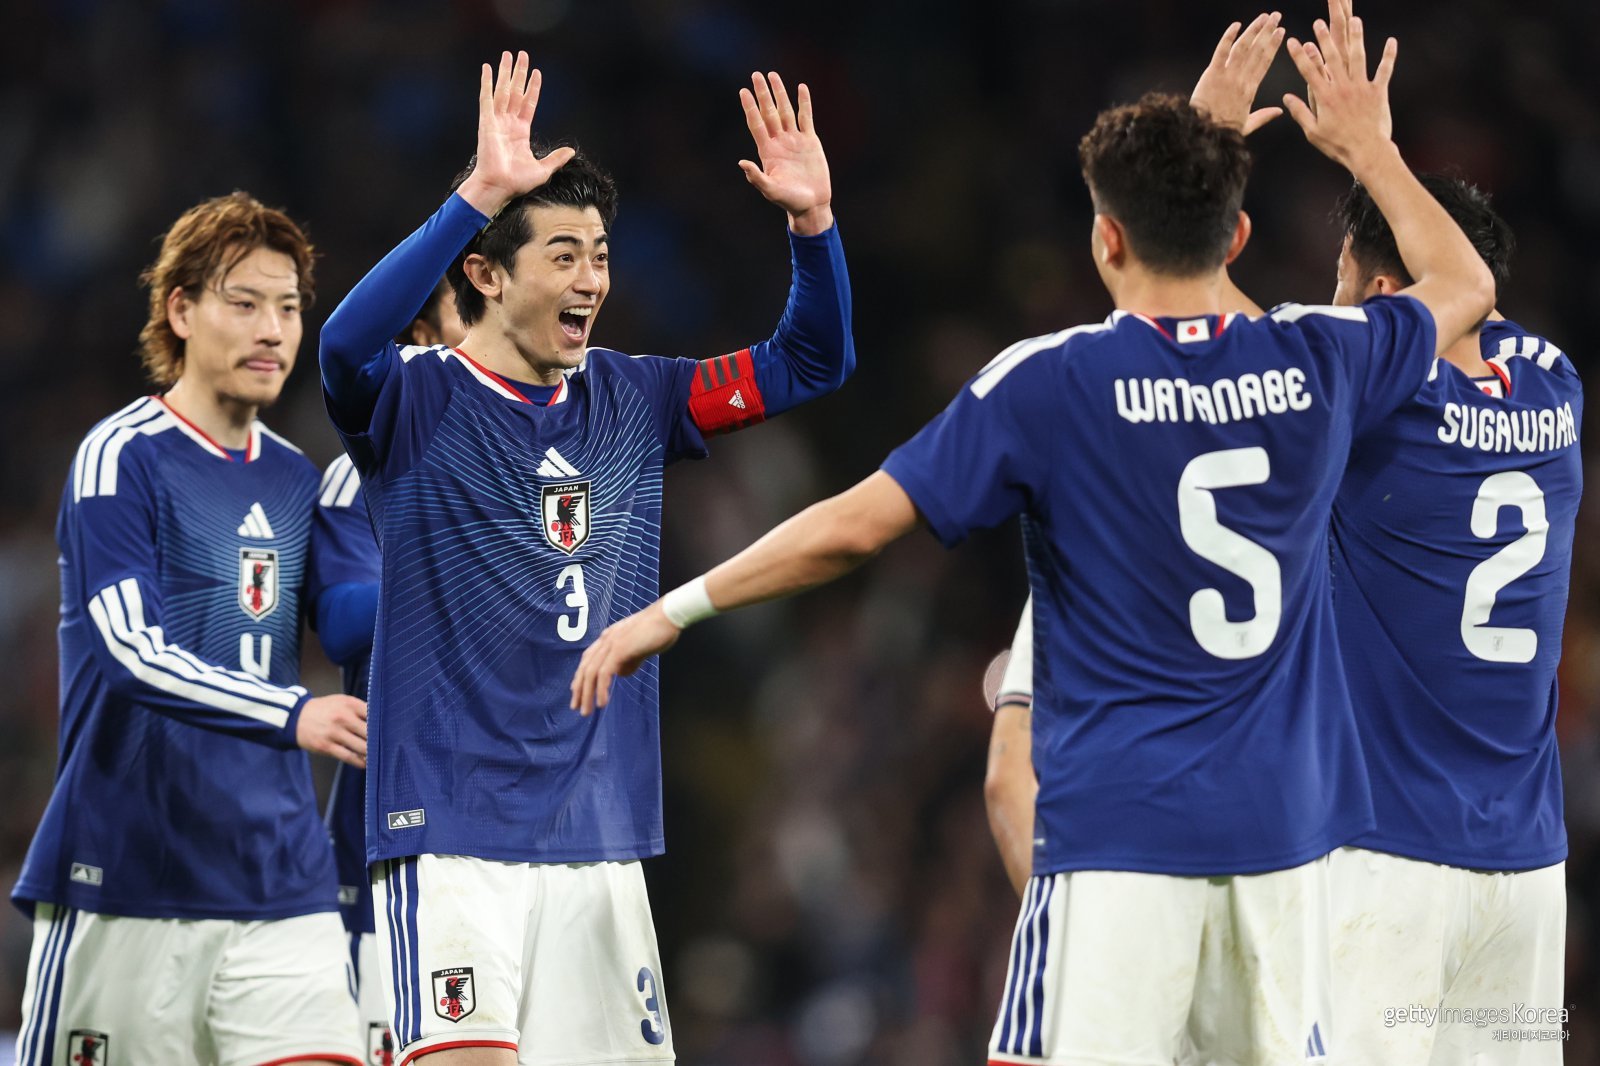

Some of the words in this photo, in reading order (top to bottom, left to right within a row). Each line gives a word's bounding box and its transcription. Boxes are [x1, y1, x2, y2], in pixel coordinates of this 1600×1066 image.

[1114, 367, 1312, 425] WATANABE
[553, 484, 579, 493] JAPAN
[558, 530, 577, 543] JFA
[1177, 446, 1282, 660] 5
[1460, 471, 1549, 664] 2
[556, 563, 589, 642] 3
[440, 968, 464, 976] JAPAN
[445, 1003, 465, 1015] JFA
[637, 966, 665, 1045] 3
